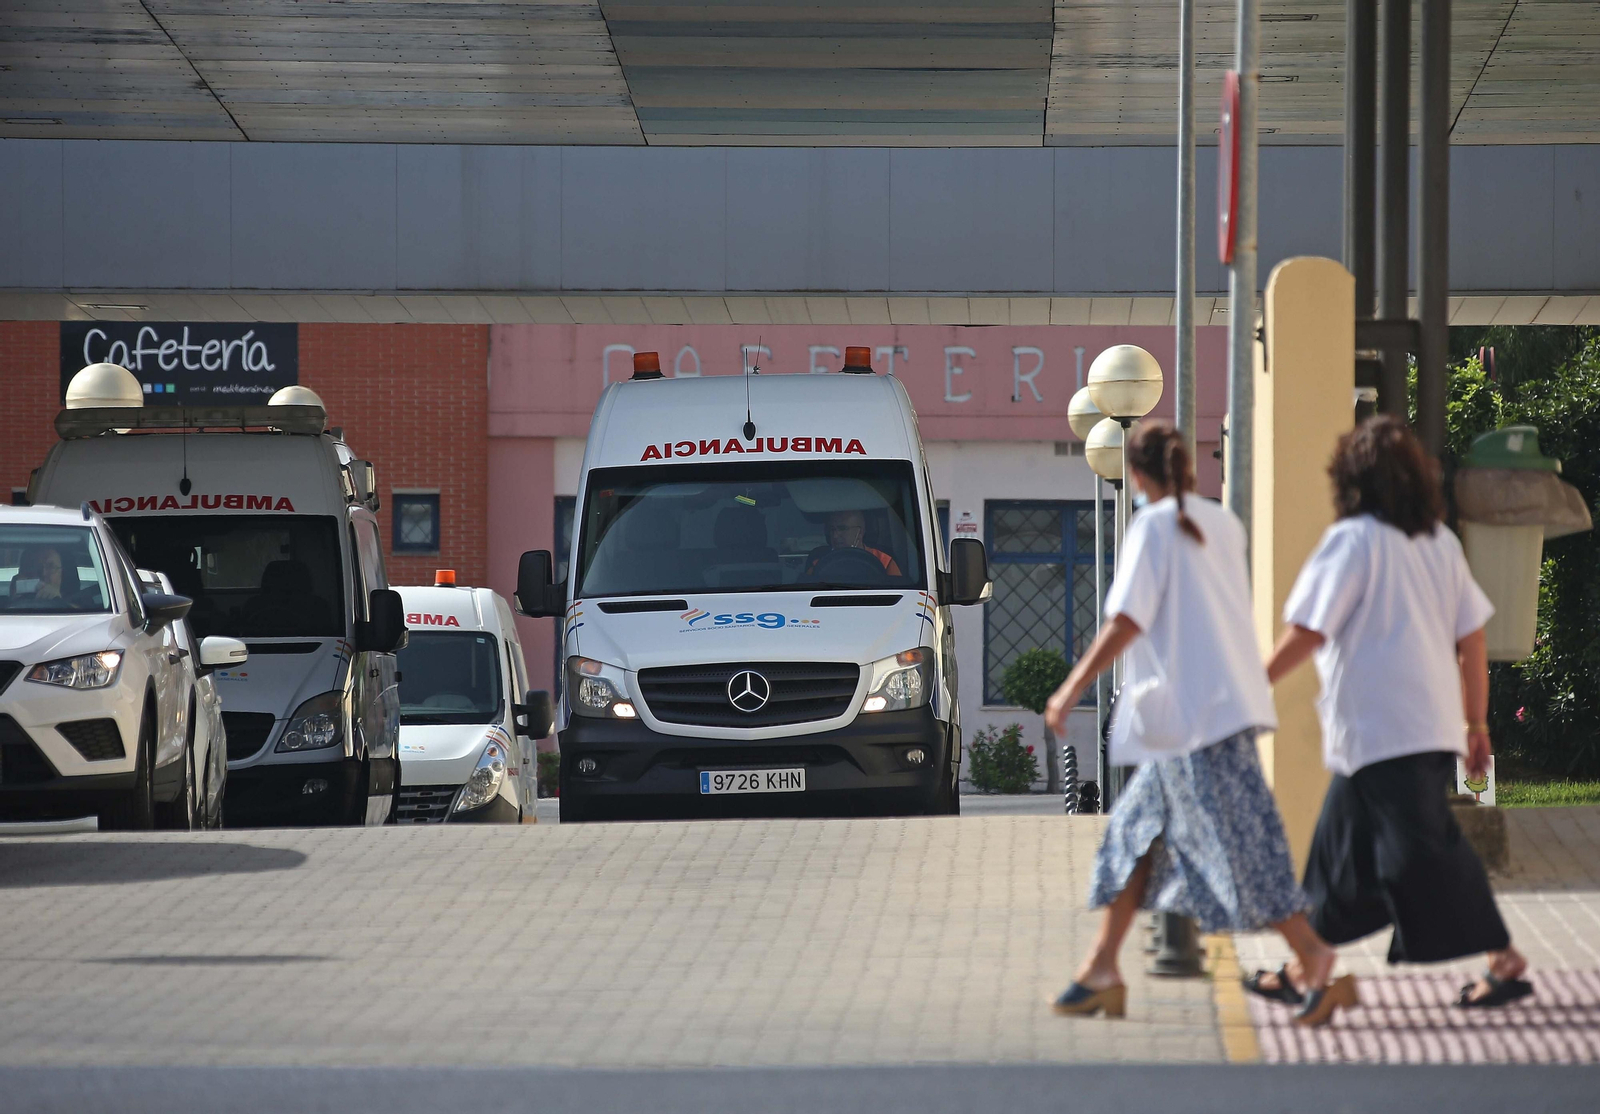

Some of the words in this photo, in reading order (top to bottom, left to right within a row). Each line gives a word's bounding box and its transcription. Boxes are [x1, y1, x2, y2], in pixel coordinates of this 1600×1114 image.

[83, 326, 276, 372] Cafetería
[713, 612, 786, 629] ssg
[713, 773, 760, 791] 9726
[766, 772, 801, 790] KHN
